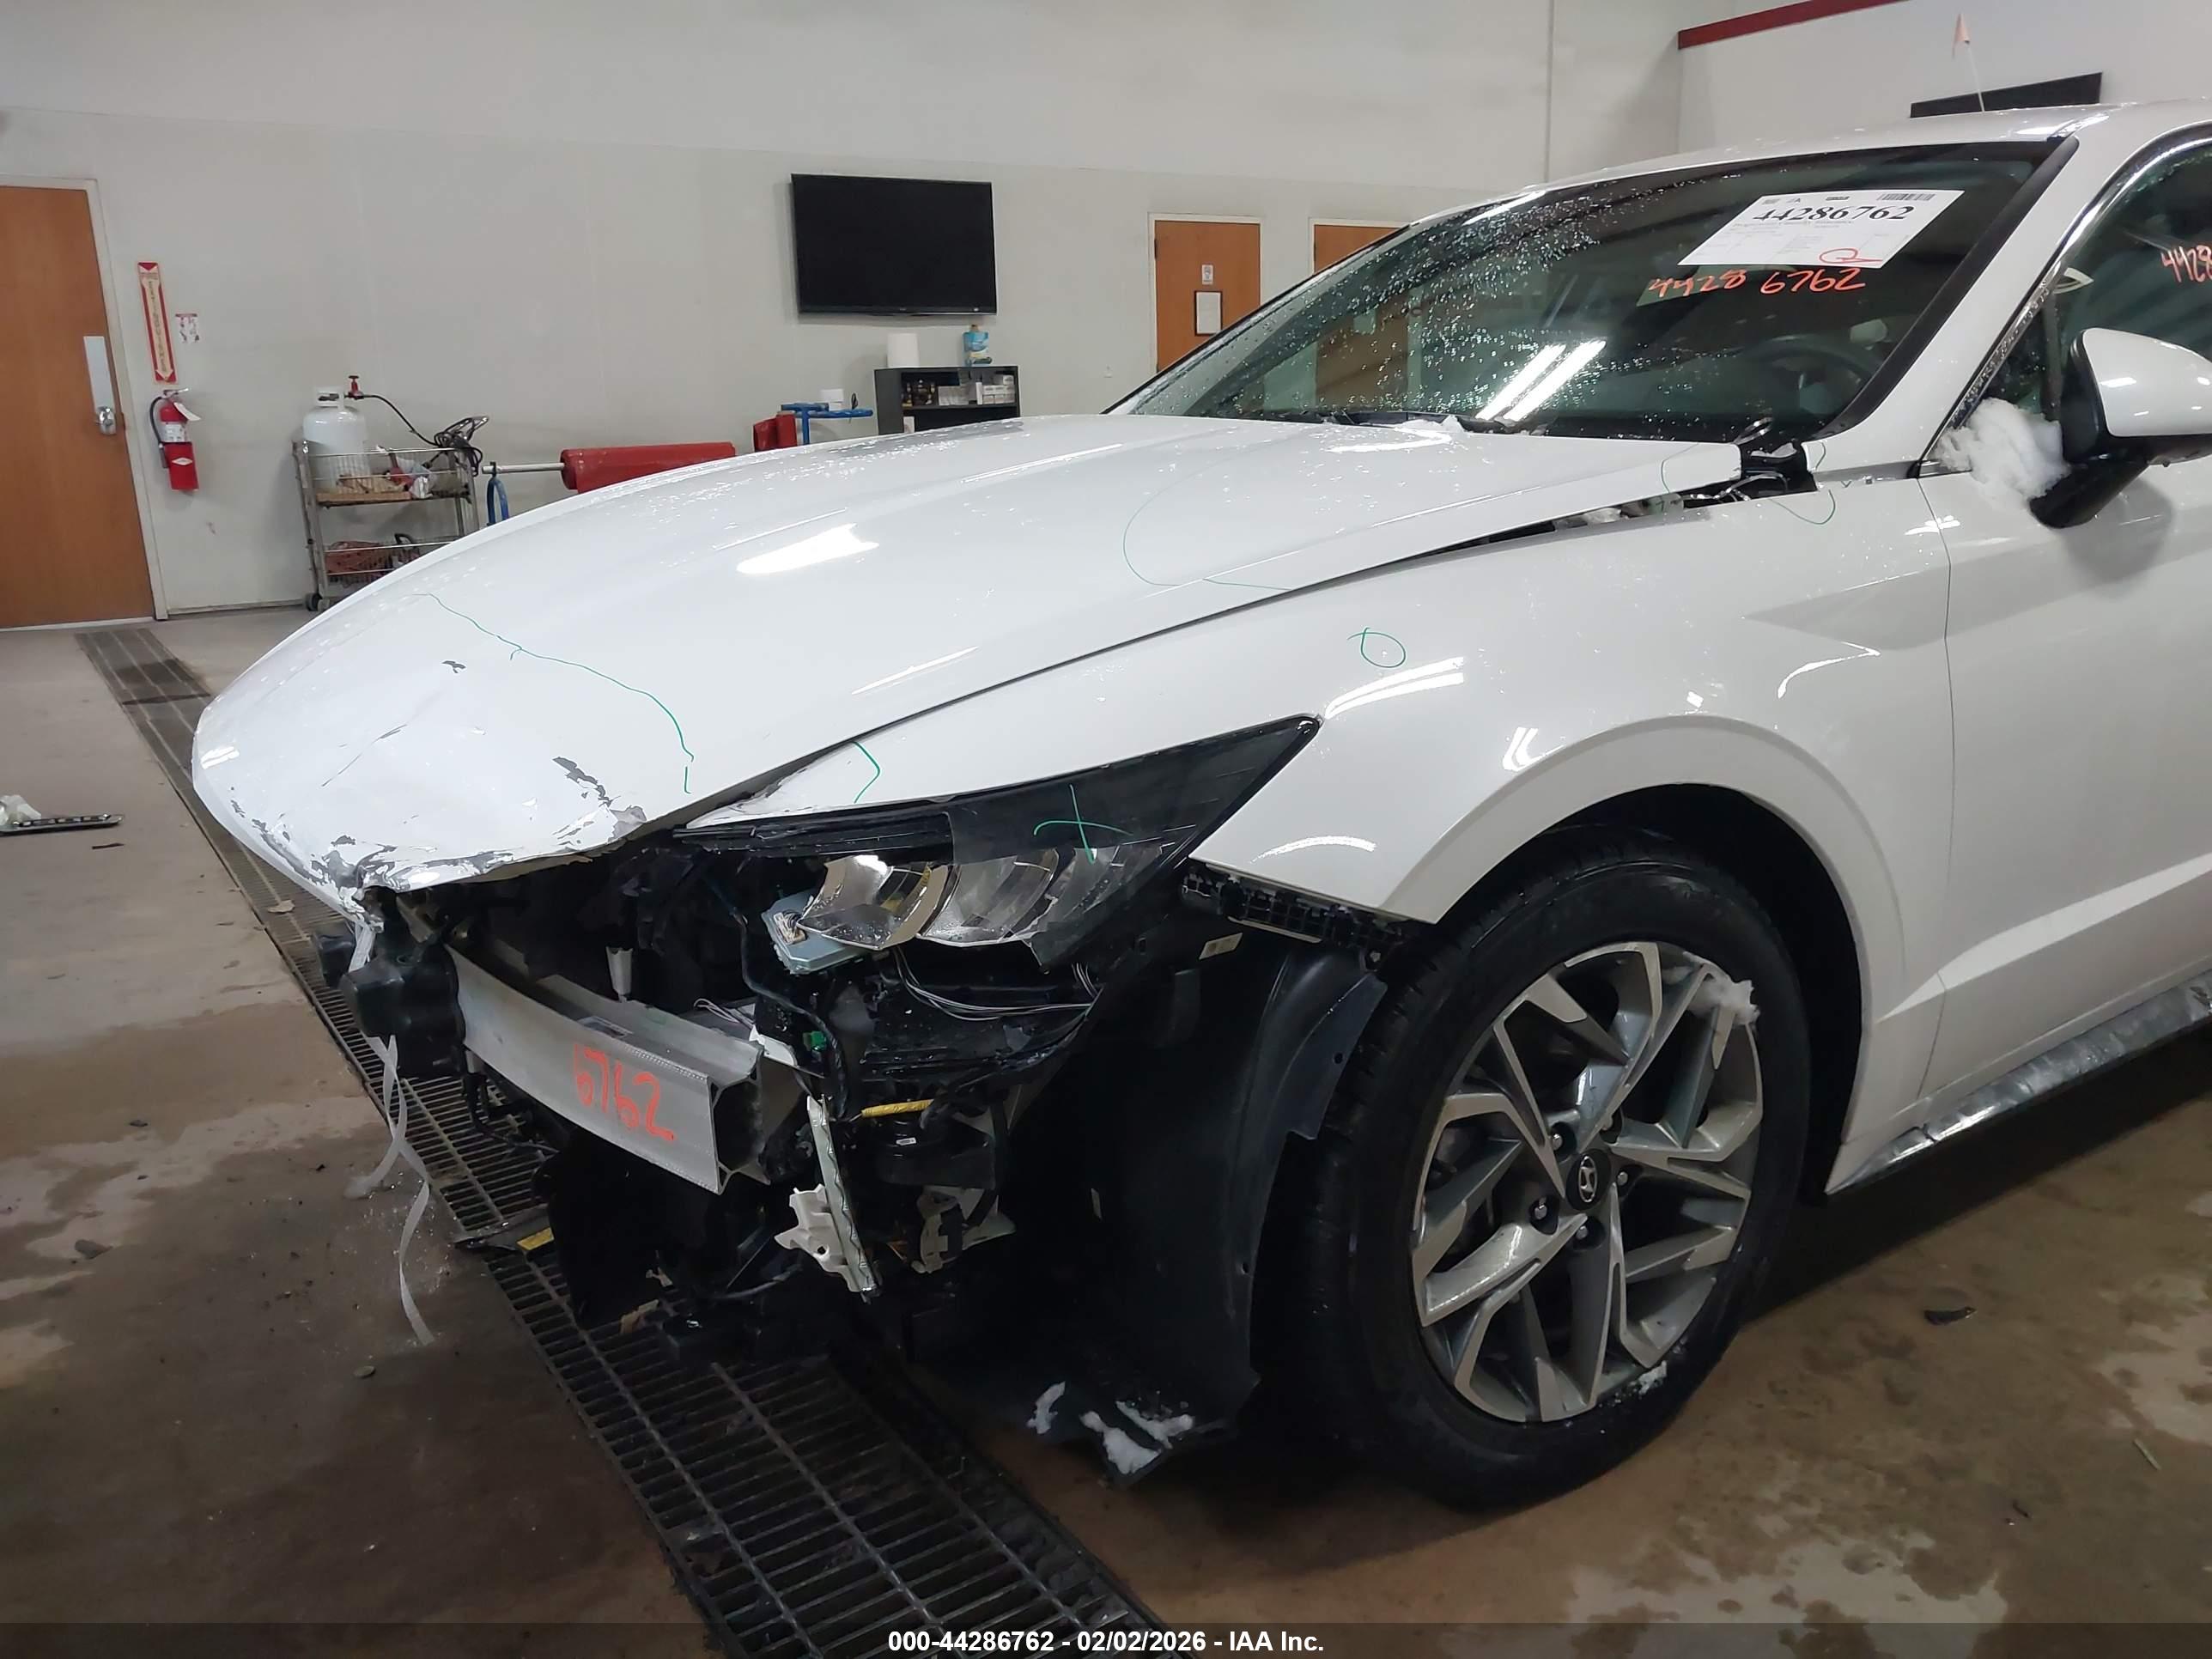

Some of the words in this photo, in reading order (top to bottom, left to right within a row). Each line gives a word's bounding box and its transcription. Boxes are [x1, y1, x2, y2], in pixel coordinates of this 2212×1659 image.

[1753, 205, 1915, 221] 44286762
[1648, 269, 1747, 297] 4428
[1760, 268, 1866, 294] 6762
[574, 1043, 676, 1142] 6762
